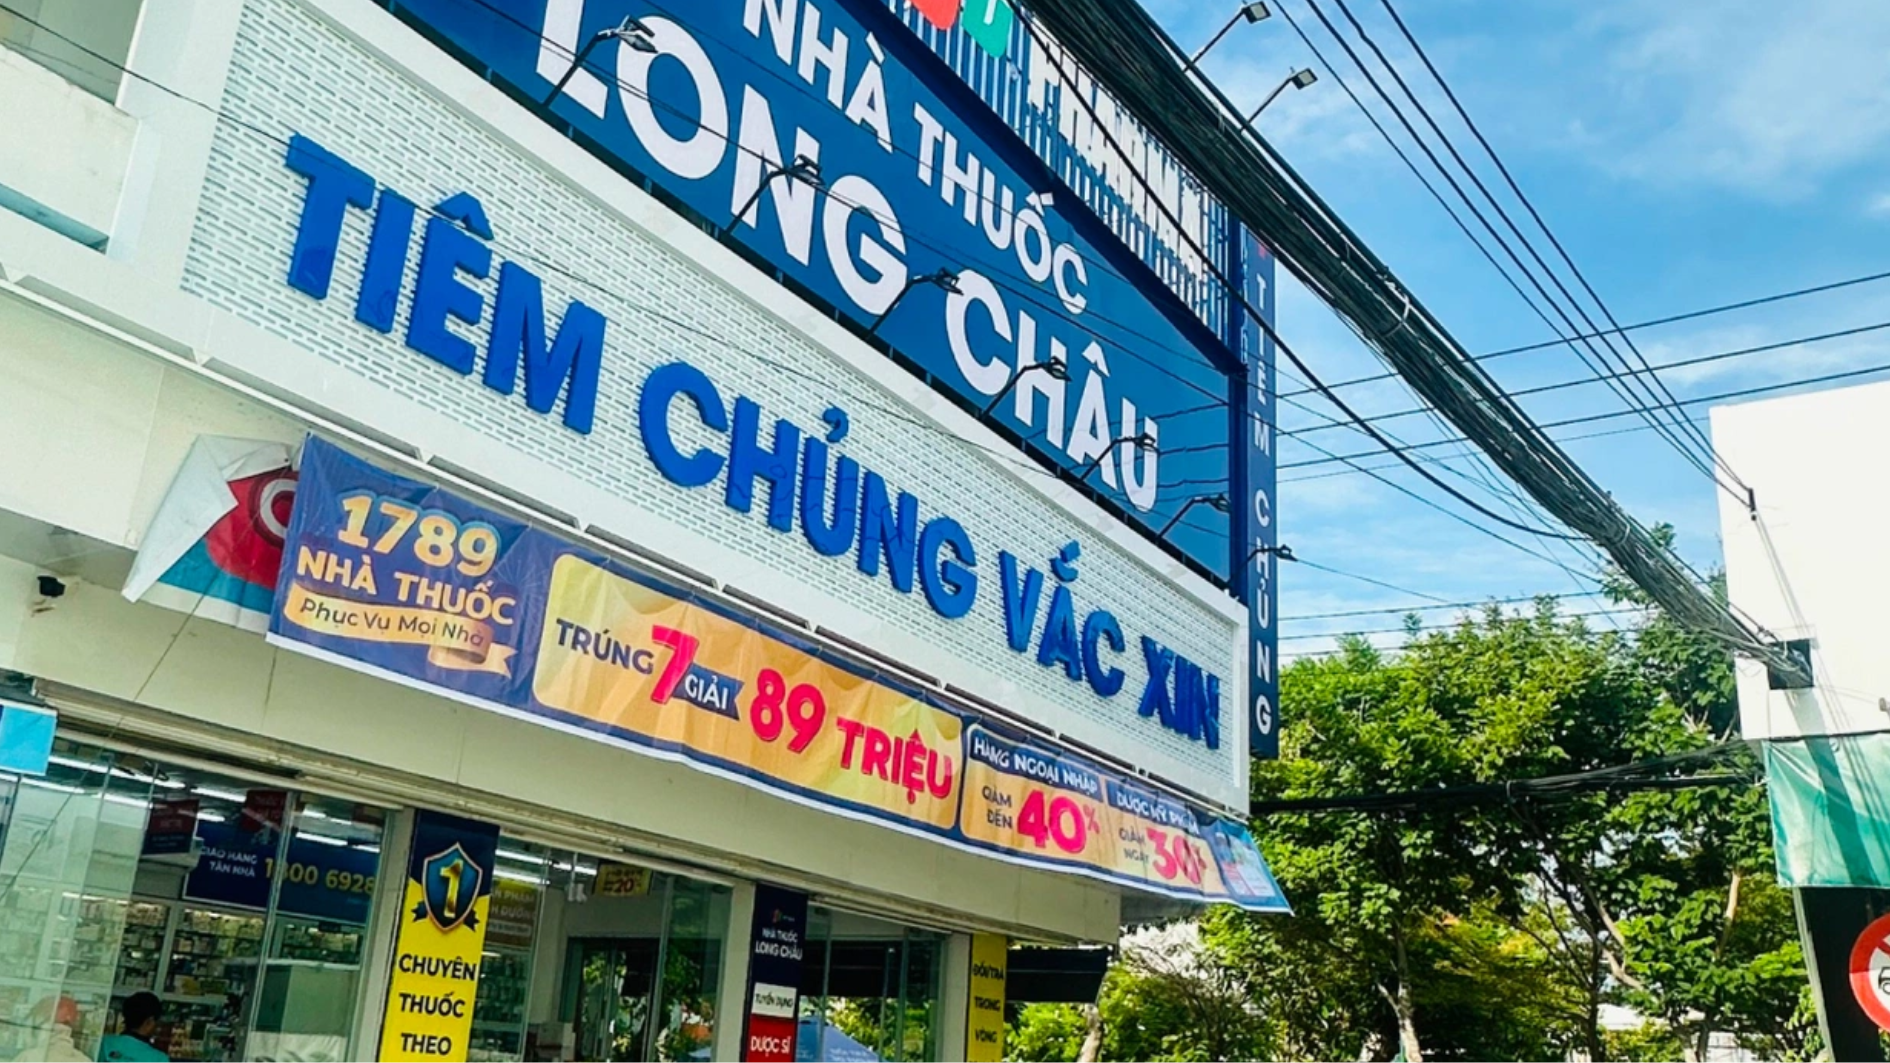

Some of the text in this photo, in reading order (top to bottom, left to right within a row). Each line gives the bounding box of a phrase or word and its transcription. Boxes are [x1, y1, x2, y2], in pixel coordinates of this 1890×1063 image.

[743, 0, 893, 152] NHÀ
[914, 102, 1088, 315] THUỐC
[536, 0, 908, 316] LONG
[945, 268, 1159, 512] CHÂU
[284, 131, 1221, 751] TIÊM CHỦNG VẮC XIN
[337, 494, 499, 577] 1789
[1253, 272, 1273, 736] TIÊM CHỦNG
[296, 545, 517, 626] NHÀ THUỐC
[300, 597, 485, 648] Phục Vụ Mọi Nhà
[555, 617, 730, 711] TRÚNG 7 GIẢI
[748, 667, 953, 805] 89 TRIỆU
[973, 736, 1011, 768] HÀNG
[1013, 753, 1060, 785] NGOẠI
[264, 857, 319, 885] 100
[440, 858, 464, 919] 1
[398, 953, 478, 982] CHUYÊN
[398, 990, 466, 1019] THUỐC
[400, 1031, 452, 1057] THEO
